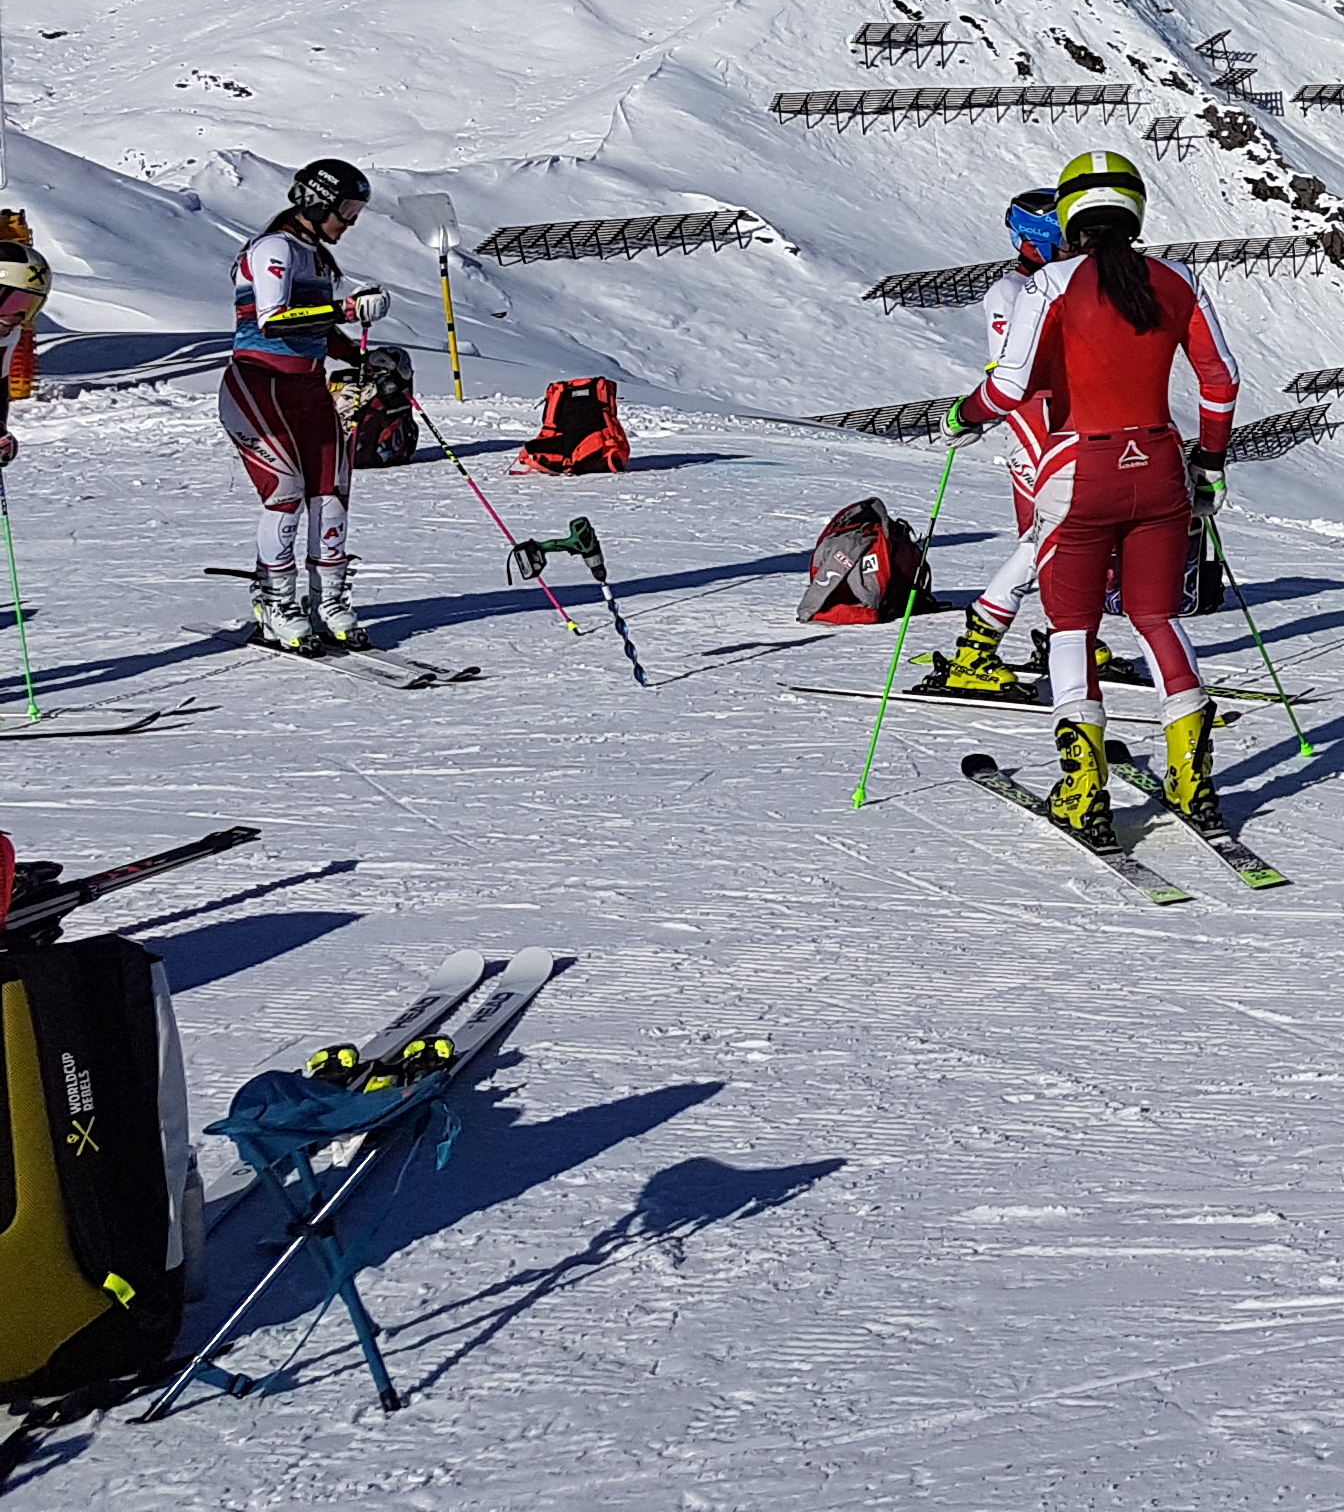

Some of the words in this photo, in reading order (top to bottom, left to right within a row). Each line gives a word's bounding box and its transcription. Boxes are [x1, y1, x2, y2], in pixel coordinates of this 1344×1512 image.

[318, 170, 340, 185] uvex
[308, 179, 336, 202] uvex
[282, 310, 310, 319] LEKI
[863, 557, 876, 571] A1
[950, 663, 1000, 683] FISCHER
[385, 996, 440, 1031] HEAD
[467, 992, 515, 1023] HEAD
[61, 1052, 82, 1116] WORLDCUP
[78, 1069, 95, 1112] REBELS
